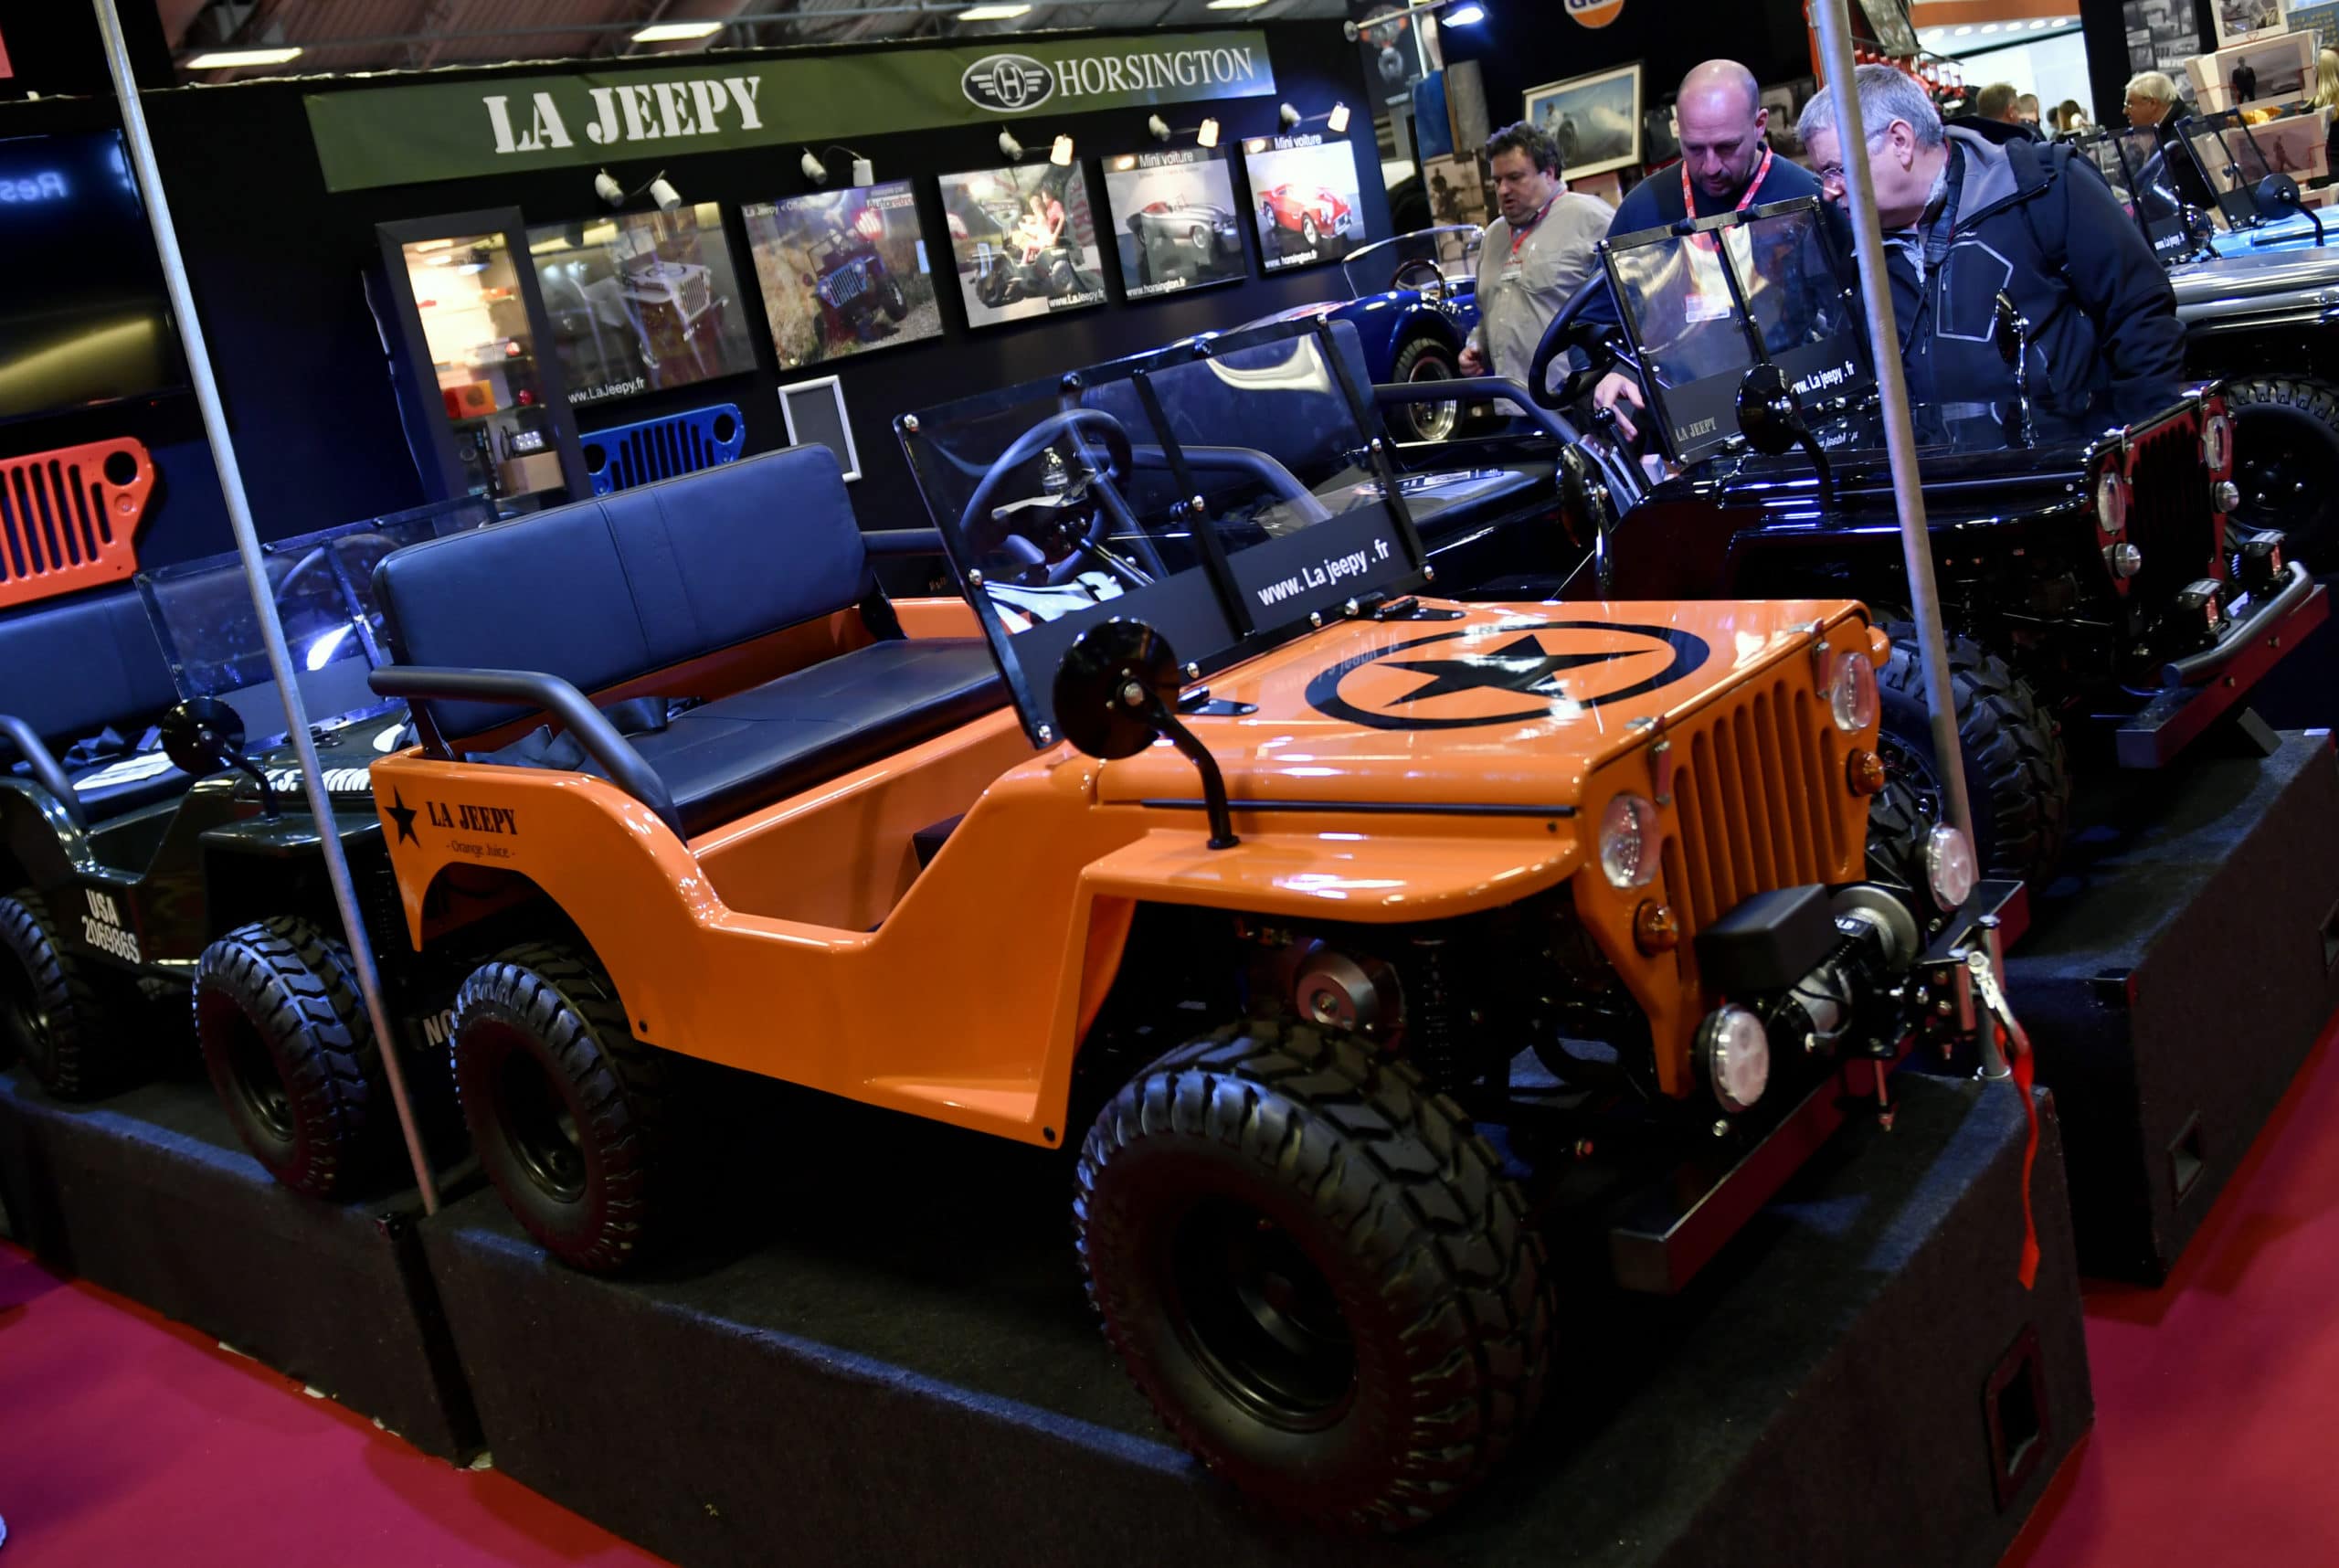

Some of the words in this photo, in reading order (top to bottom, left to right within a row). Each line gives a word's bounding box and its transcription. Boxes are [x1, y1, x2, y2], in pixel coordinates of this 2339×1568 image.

[1054, 48, 1254, 97] HORSINGTON
[482, 92, 574, 154] LA
[587, 76, 763, 144] JEEPY
[1274, 135, 1294, 150] Mini
[1293, 133, 1322, 147] voiture
[1138, 153, 1160, 169] Mini
[1160, 151, 1194, 165] voiture
[1675, 427, 1689, 442] LA
[1688, 416, 1717, 438] JEEPY
[426, 800, 454, 828] LA
[458, 804, 518, 835] JEEPY
[85, 888, 121, 928] USA
